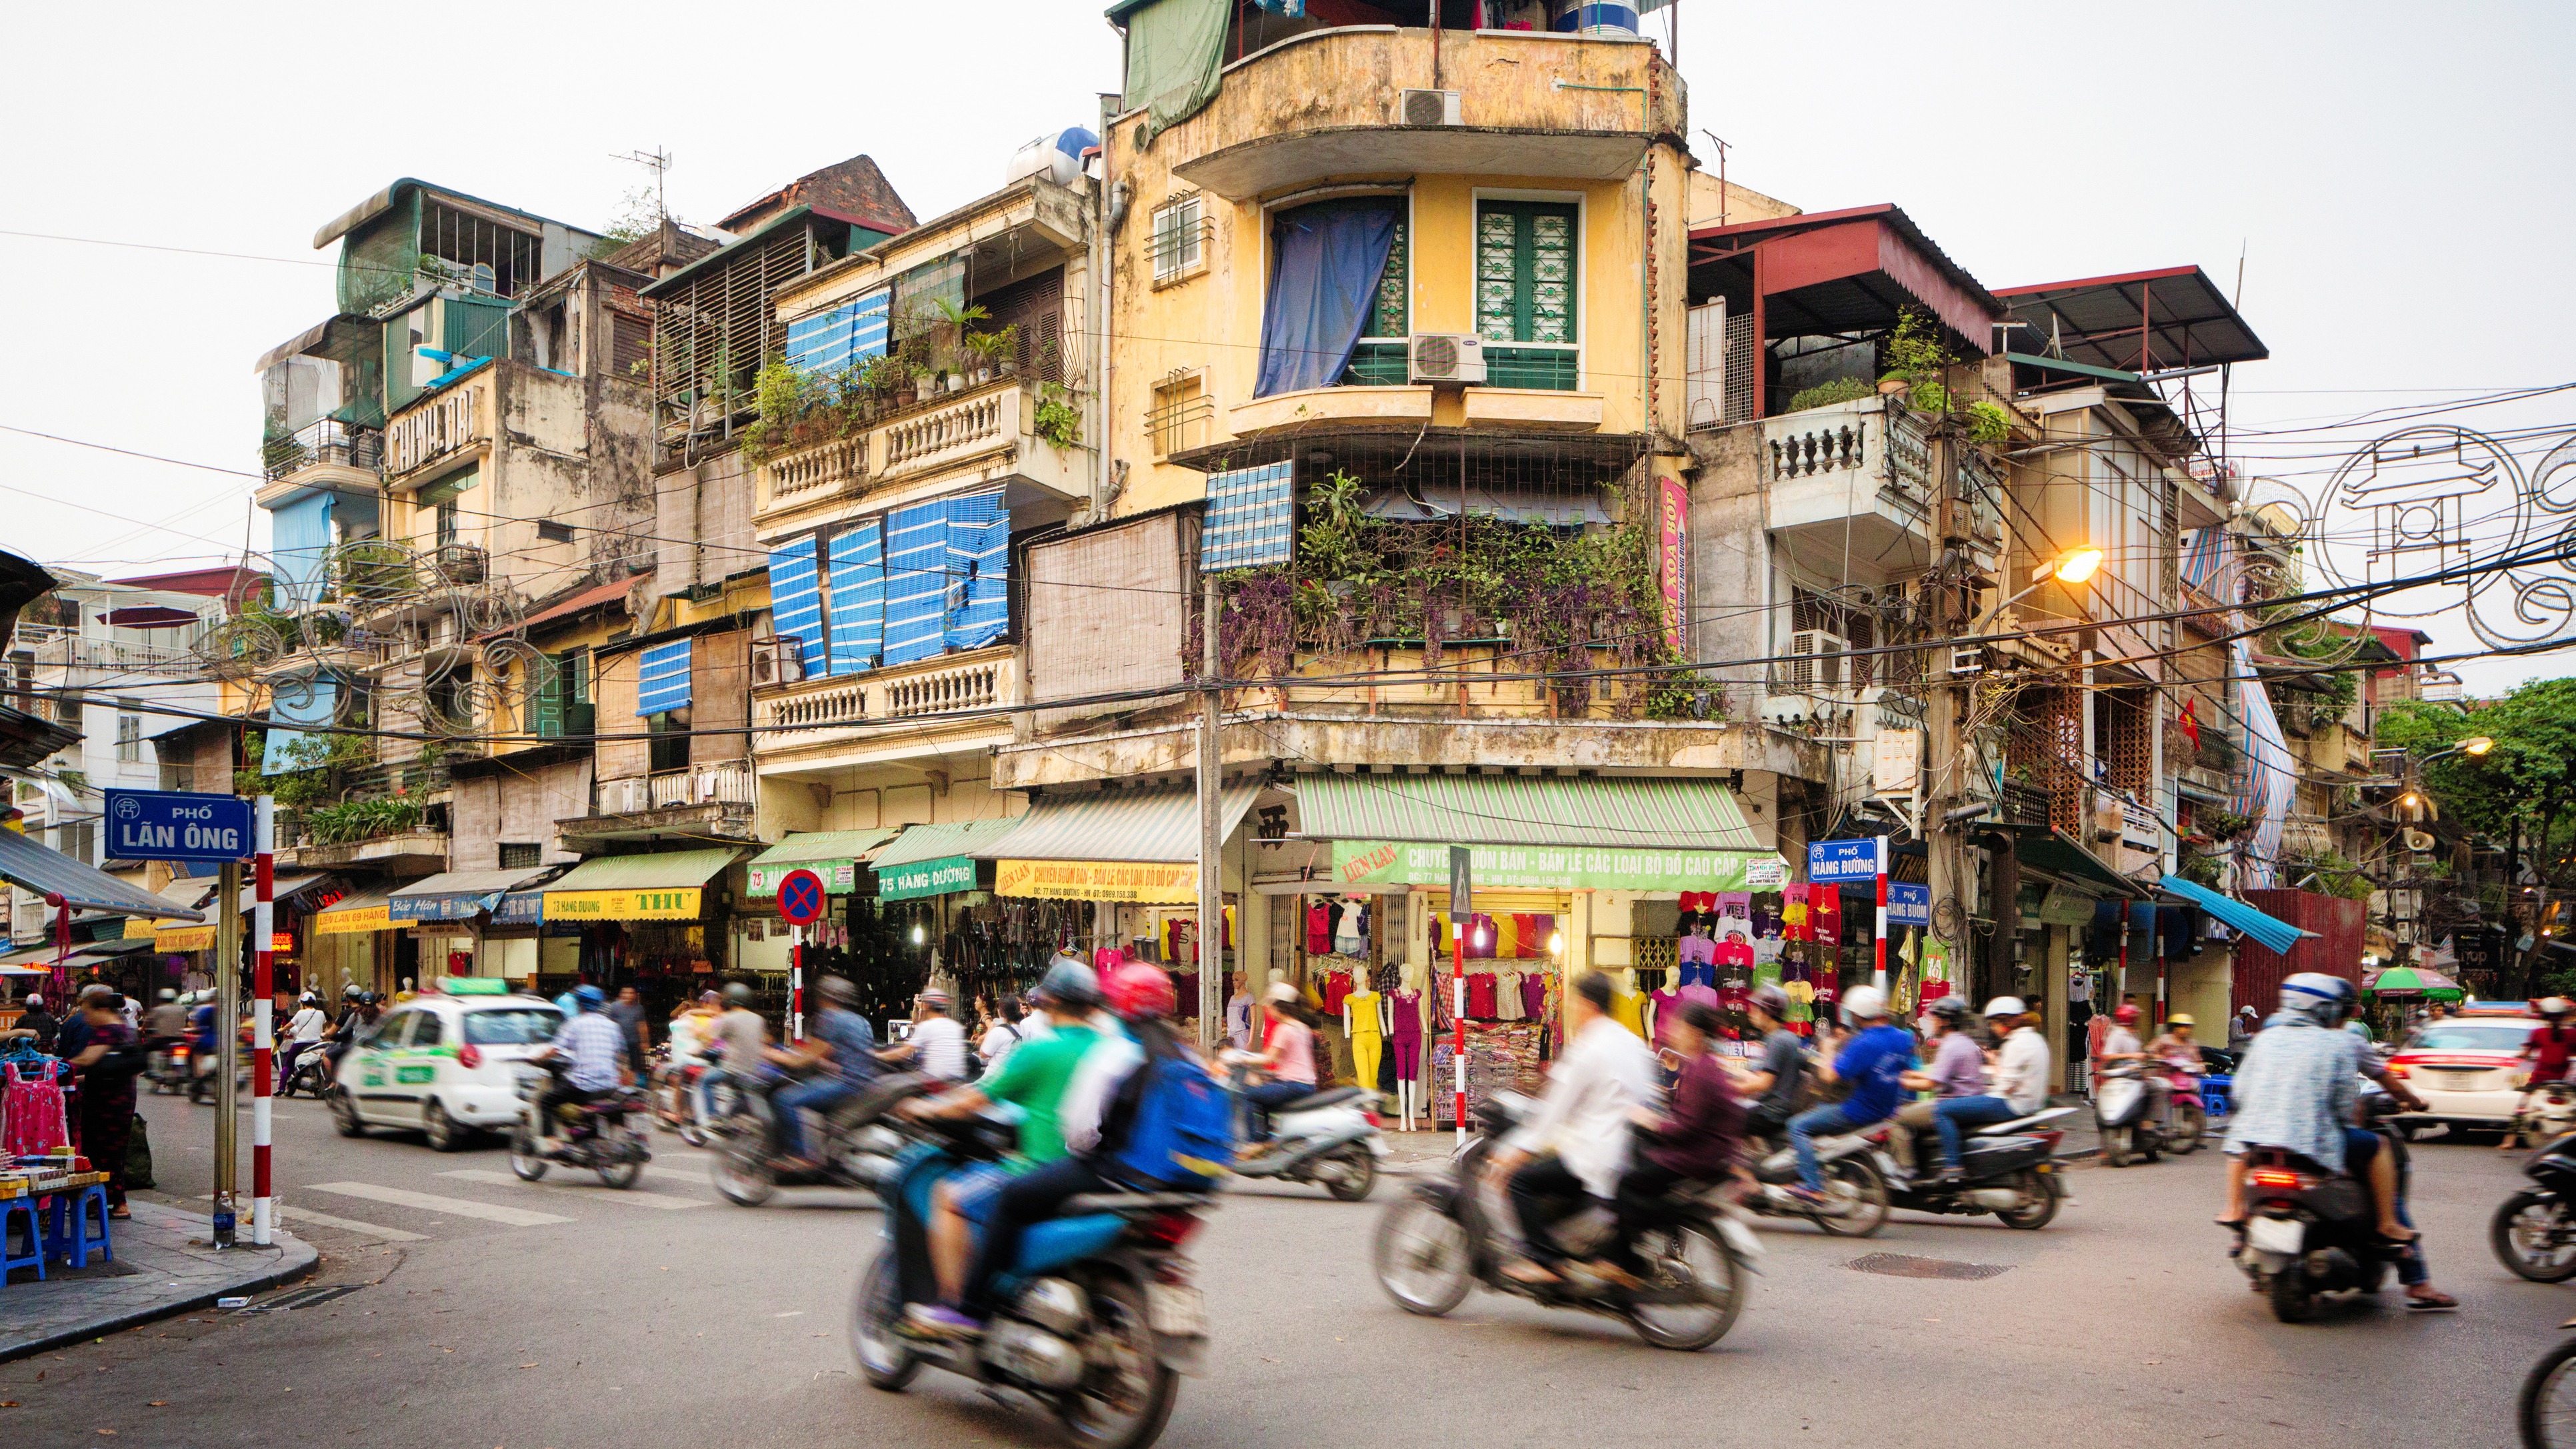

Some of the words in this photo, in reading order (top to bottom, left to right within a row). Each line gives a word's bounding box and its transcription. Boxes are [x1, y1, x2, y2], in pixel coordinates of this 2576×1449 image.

[1664, 490, 1677, 536] BÓP
[1666, 544, 1677, 591] XOA
[1679, 581, 1685, 591] 72
[172, 804, 213, 820] PHỐ
[123, 821, 175, 848] LÃN
[185, 822, 238, 850] ÔNG
[1839, 845, 1859, 856] PHỐ
[1341, 855, 1373, 883] LIÊN
[1369, 843, 1397, 870] LAN
[1409, 846, 1450, 869] CHUYÊ
[1470, 846, 1497, 870] UÔN
[1500, 848, 1526, 871] BÁN
[1539, 848, 1565, 872] BÁN
[1586, 850, 1611, 874] CÁC
[1614, 854, 1641, 878] LOẠI
[1645, 852, 1662, 880] BỘ
[1685, 857, 1711, 876] CAO
[1813, 858, 1839, 876] HÀNG
[1841, 856, 1875, 874] ĐƯỜNG
[753, 873, 762, 887] 75
[879, 878, 895, 893] 75
[898, 872, 929, 891] HÀNG
[999, 871, 1016, 892] LIÊN
[1015, 863, 1031, 882] LAN
[1117, 866, 1129, 886] CÁC
[1167, 870, 1179, 888] CAO
[1424, 873, 1432, 882] 77
[1435, 871, 1450, 882] HÀN
[635, 892, 693, 910] THU
[1084, 889, 1091, 897] HN
[1102, 890, 1137, 899] 0989.158.338
[335, 912, 351, 922] LAN
[352, 912, 361, 922] 69
[363, 908, 386, 920] HÀNG
[553, 900, 560, 912] 73
[1887, 900, 1906, 918] HÀNG
[1907, 900, 1927, 919] BUỒM
